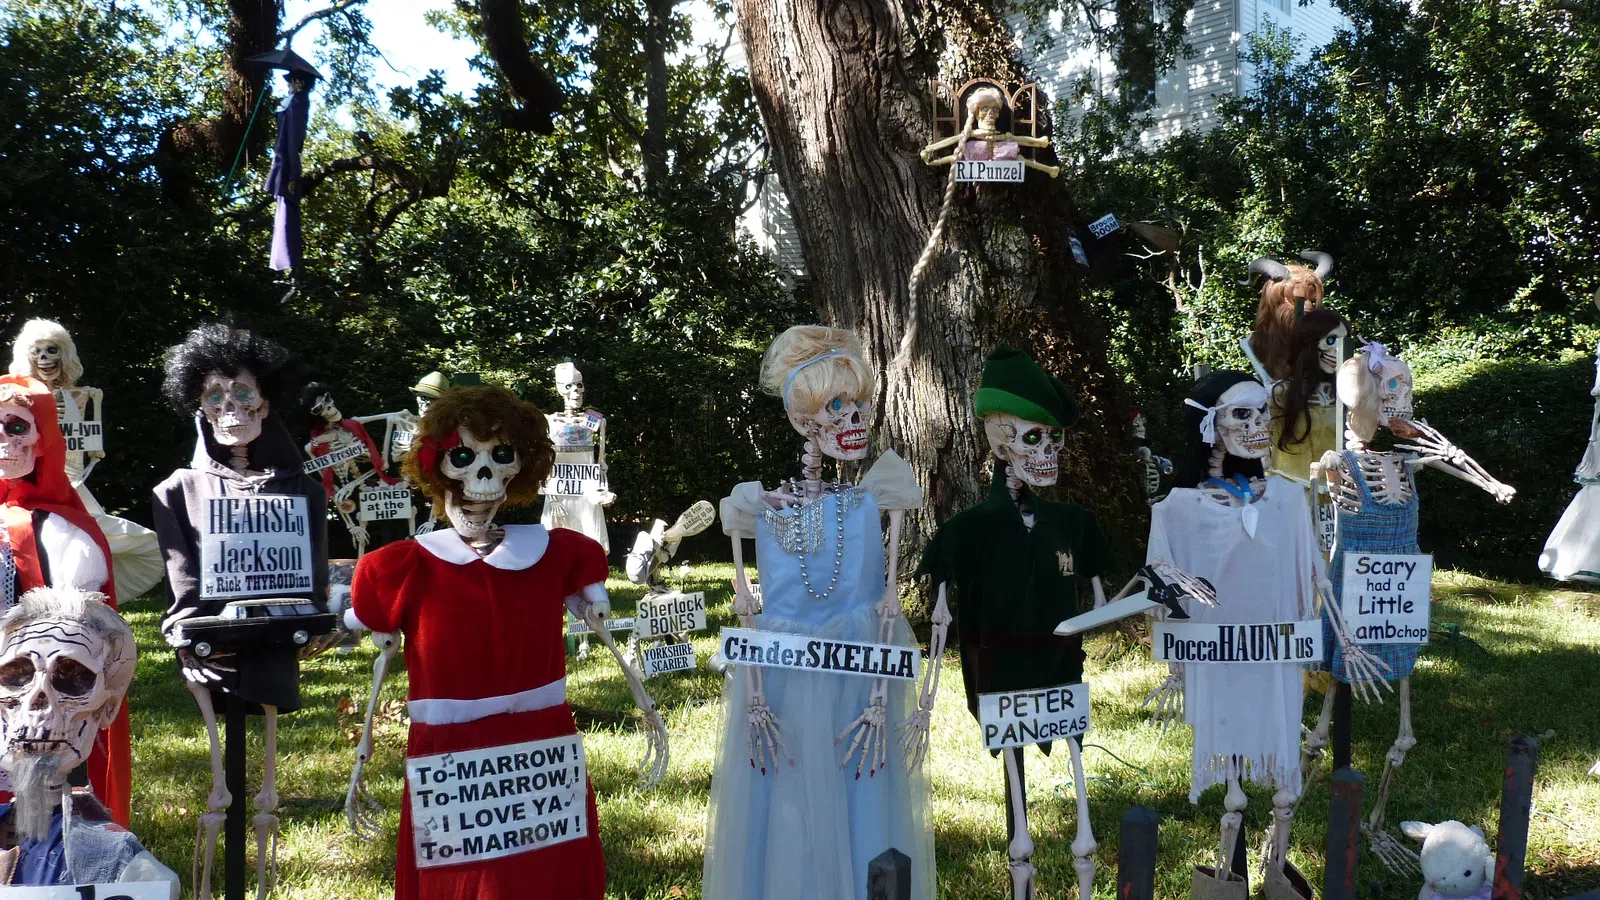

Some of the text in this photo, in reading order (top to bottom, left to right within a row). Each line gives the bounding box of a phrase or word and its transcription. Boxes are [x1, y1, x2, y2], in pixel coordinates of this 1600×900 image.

[1090, 217, 1114, 231] Broom
[64, 437, 85, 451] OE
[551, 464, 600, 481] OURNING
[361, 490, 409, 502] JOINED
[556, 480, 584, 495] CALL
[367, 500, 405, 511] at the
[375, 509, 397, 519] HIP
[209, 498, 304, 536] HEARSEy
[214, 540, 303, 573] Jackson
[1355, 556, 1416, 581] Scary
[216, 576, 241, 592] Rick
[245, 573, 310, 591] THYROIDian
[1367, 578, 1405, 591] had a
[640, 594, 703, 619] Sherlock
[1359, 594, 1414, 615] Little
[650, 612, 696, 635] BONES
[1353, 619, 1427, 641] ambchop
[644, 643, 693, 661] YORKSHIRE
[1163, 623, 1313, 662] PoccaHAUNTus
[651, 656, 689, 673] SCARIER
[725, 636, 914, 678] CinderSKELLA
[998, 689, 1075, 718] PETER
[985, 716, 1087, 746] PANCREAS
[442, 795, 563, 833] I LOVE YA
